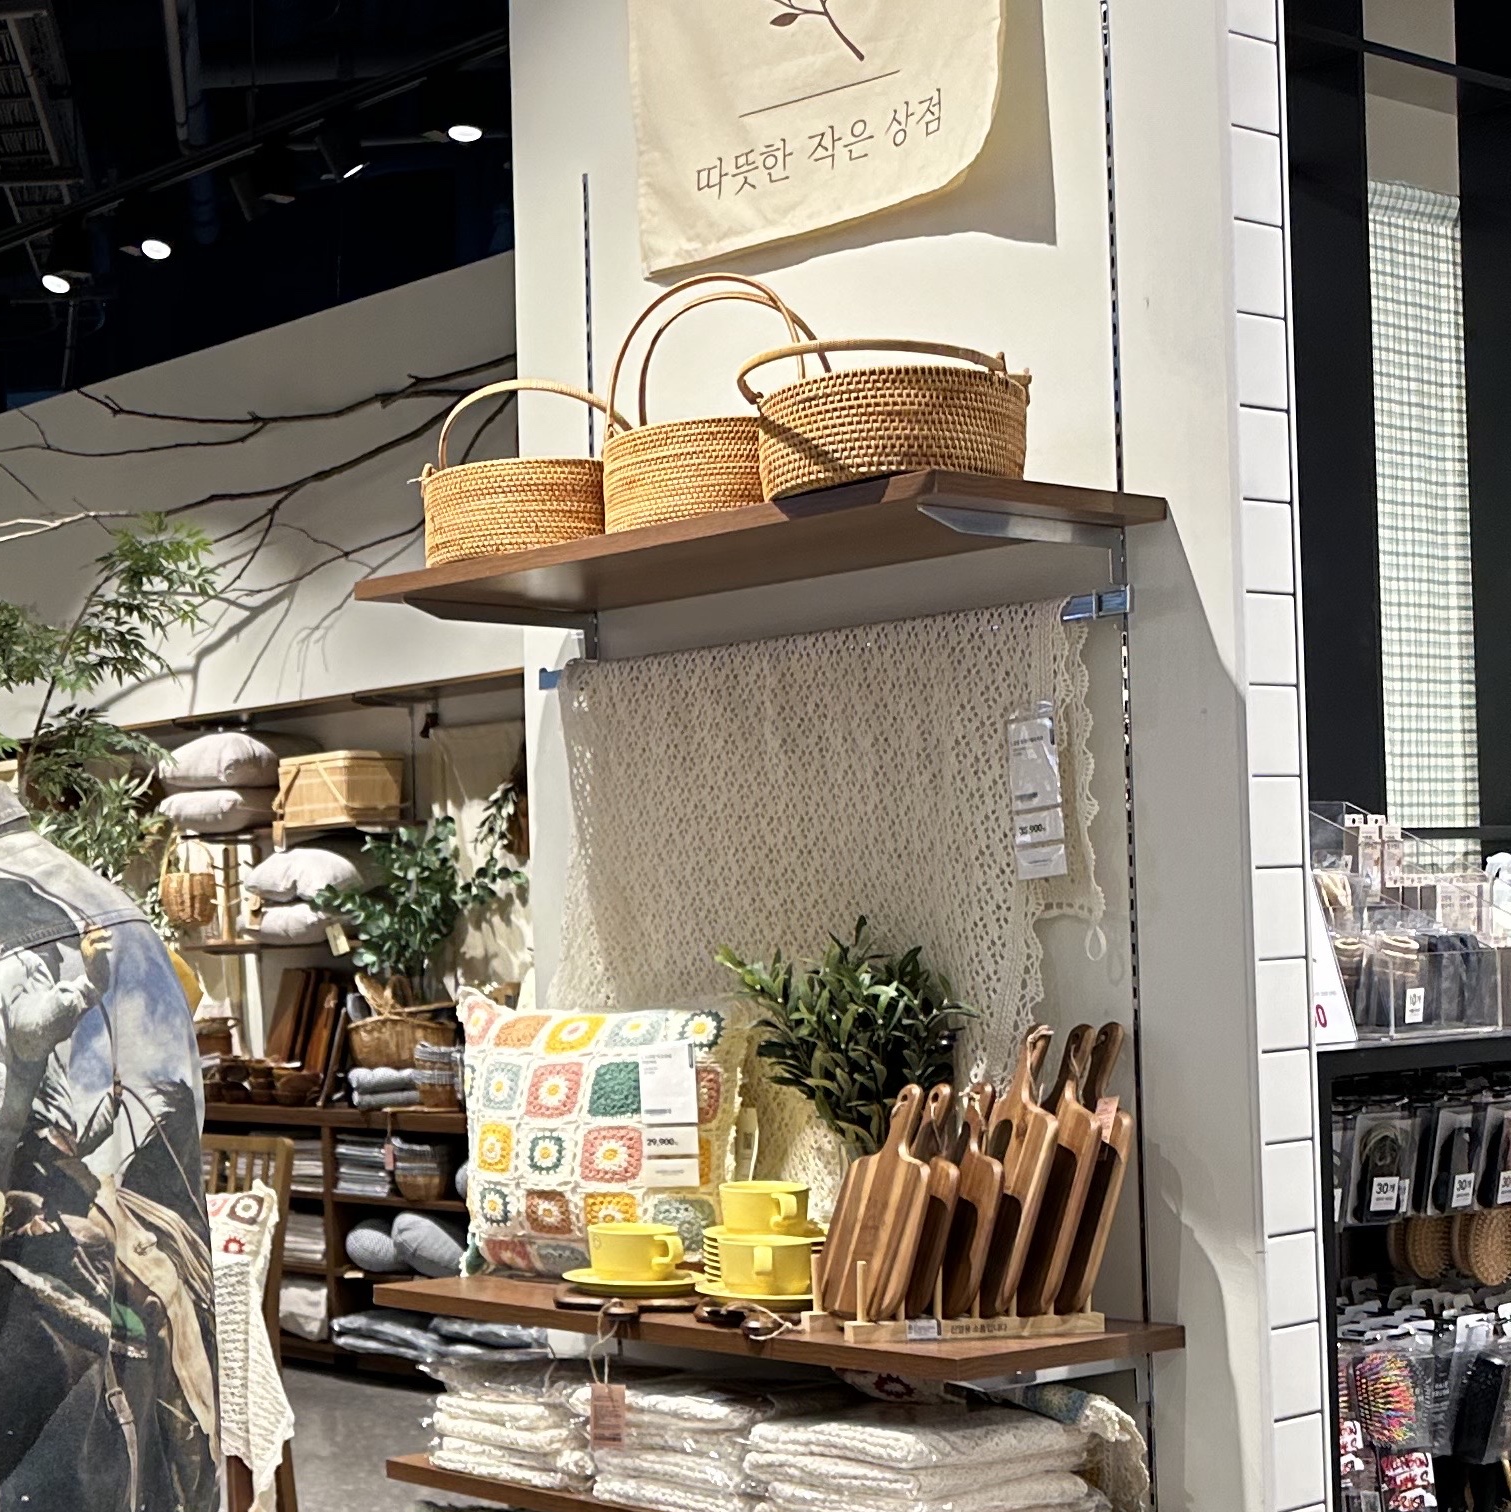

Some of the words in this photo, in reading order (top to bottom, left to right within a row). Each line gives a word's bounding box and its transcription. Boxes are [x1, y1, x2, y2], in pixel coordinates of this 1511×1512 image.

[695, 137, 794, 200] 따뜻한
[807, 118, 875, 170] 작은
[884, 87, 943, 147] 상점
